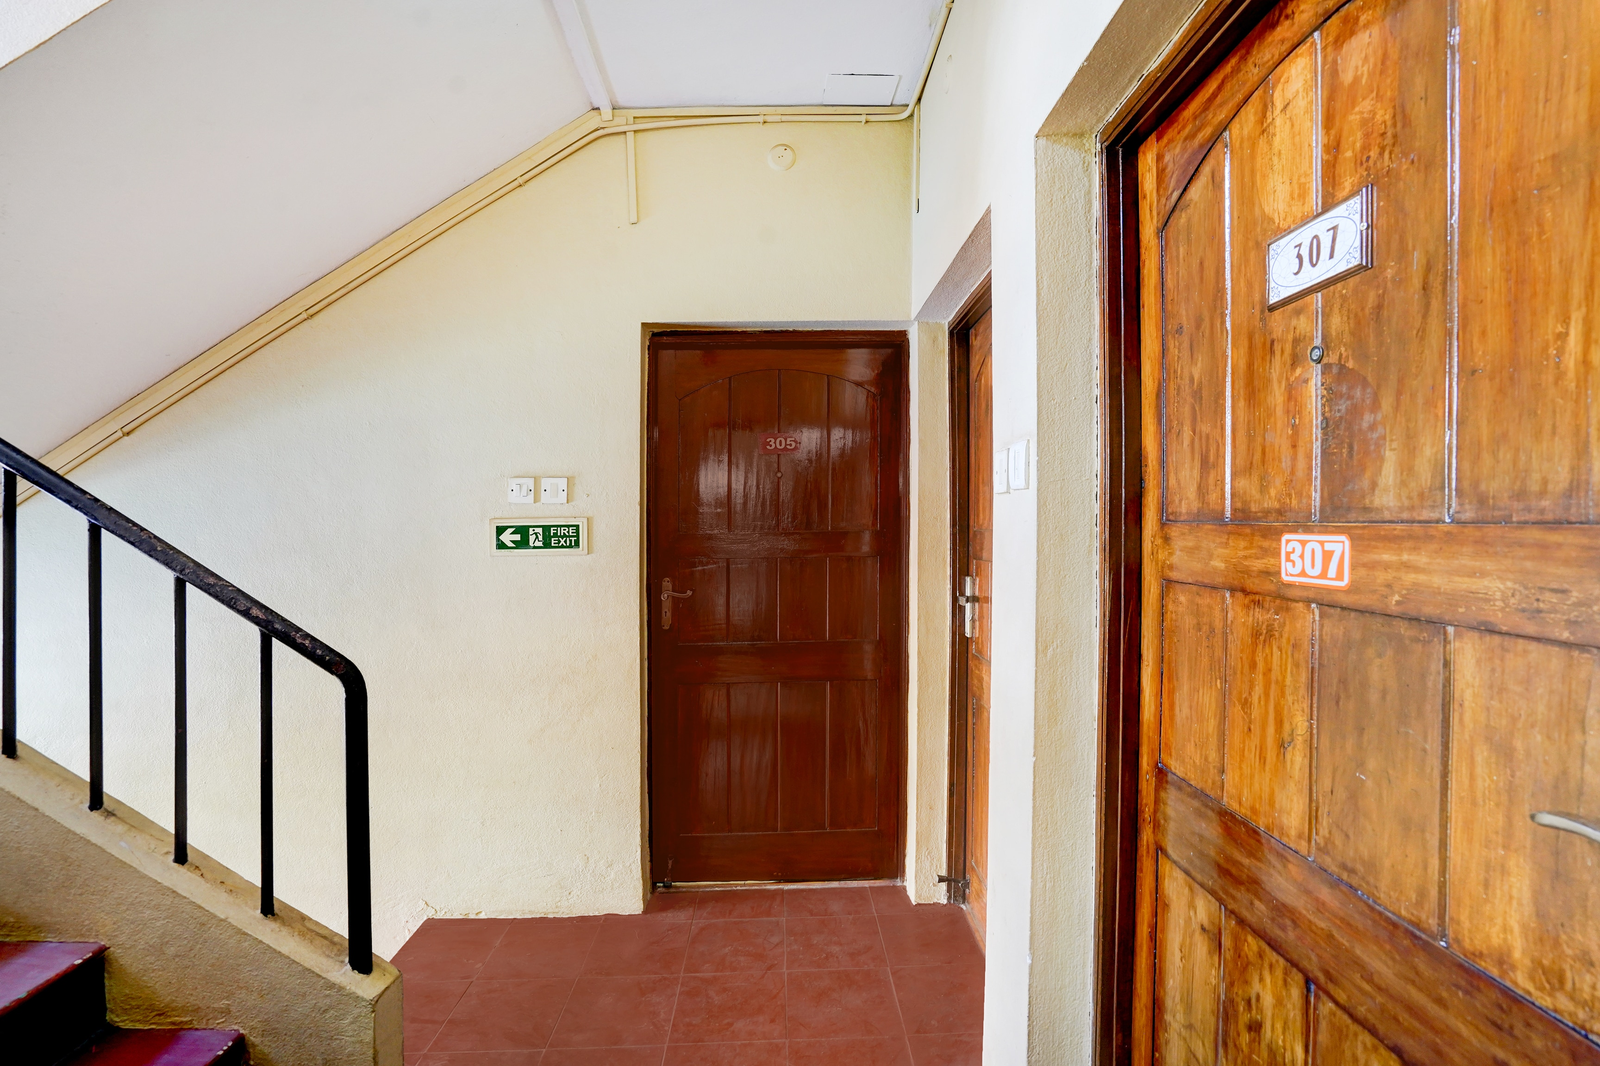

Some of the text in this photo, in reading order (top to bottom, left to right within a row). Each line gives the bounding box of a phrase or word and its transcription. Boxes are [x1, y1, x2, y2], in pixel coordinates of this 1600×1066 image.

[1292, 223, 1340, 276] 307
[766, 437, 796, 450] 305
[550, 526, 577, 536] FIRE
[551, 537, 577, 546] EXIT
[1285, 540, 1344, 579] 307
